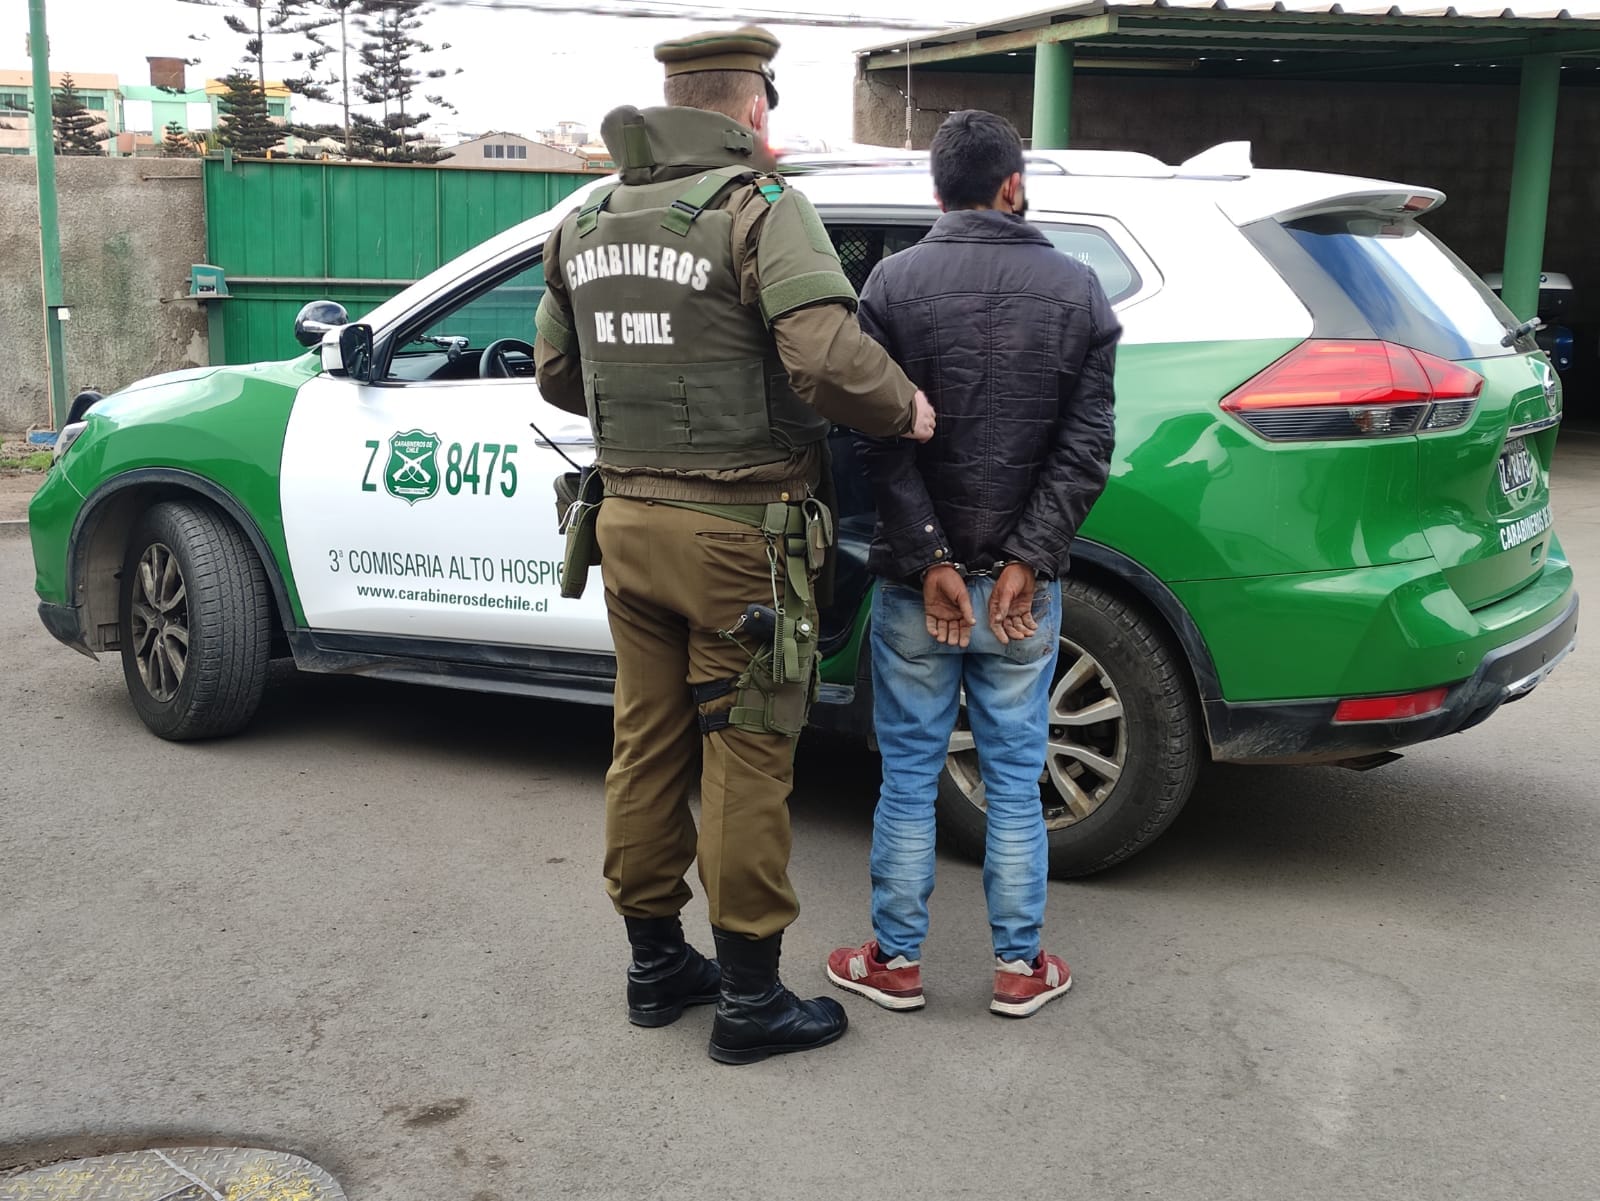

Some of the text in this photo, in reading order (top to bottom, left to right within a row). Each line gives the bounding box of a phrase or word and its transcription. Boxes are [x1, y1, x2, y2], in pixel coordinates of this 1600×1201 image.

[566, 243, 712, 291] CARABINEROS
[594, 311, 674, 344] DE CHILE
[362, 440, 519, 498] Z 8475
[349, 550, 444, 579] COMISARIA
[449, 556, 495, 582] ALTO
[356, 585, 549, 612] www.carabinerosdechile.cl
